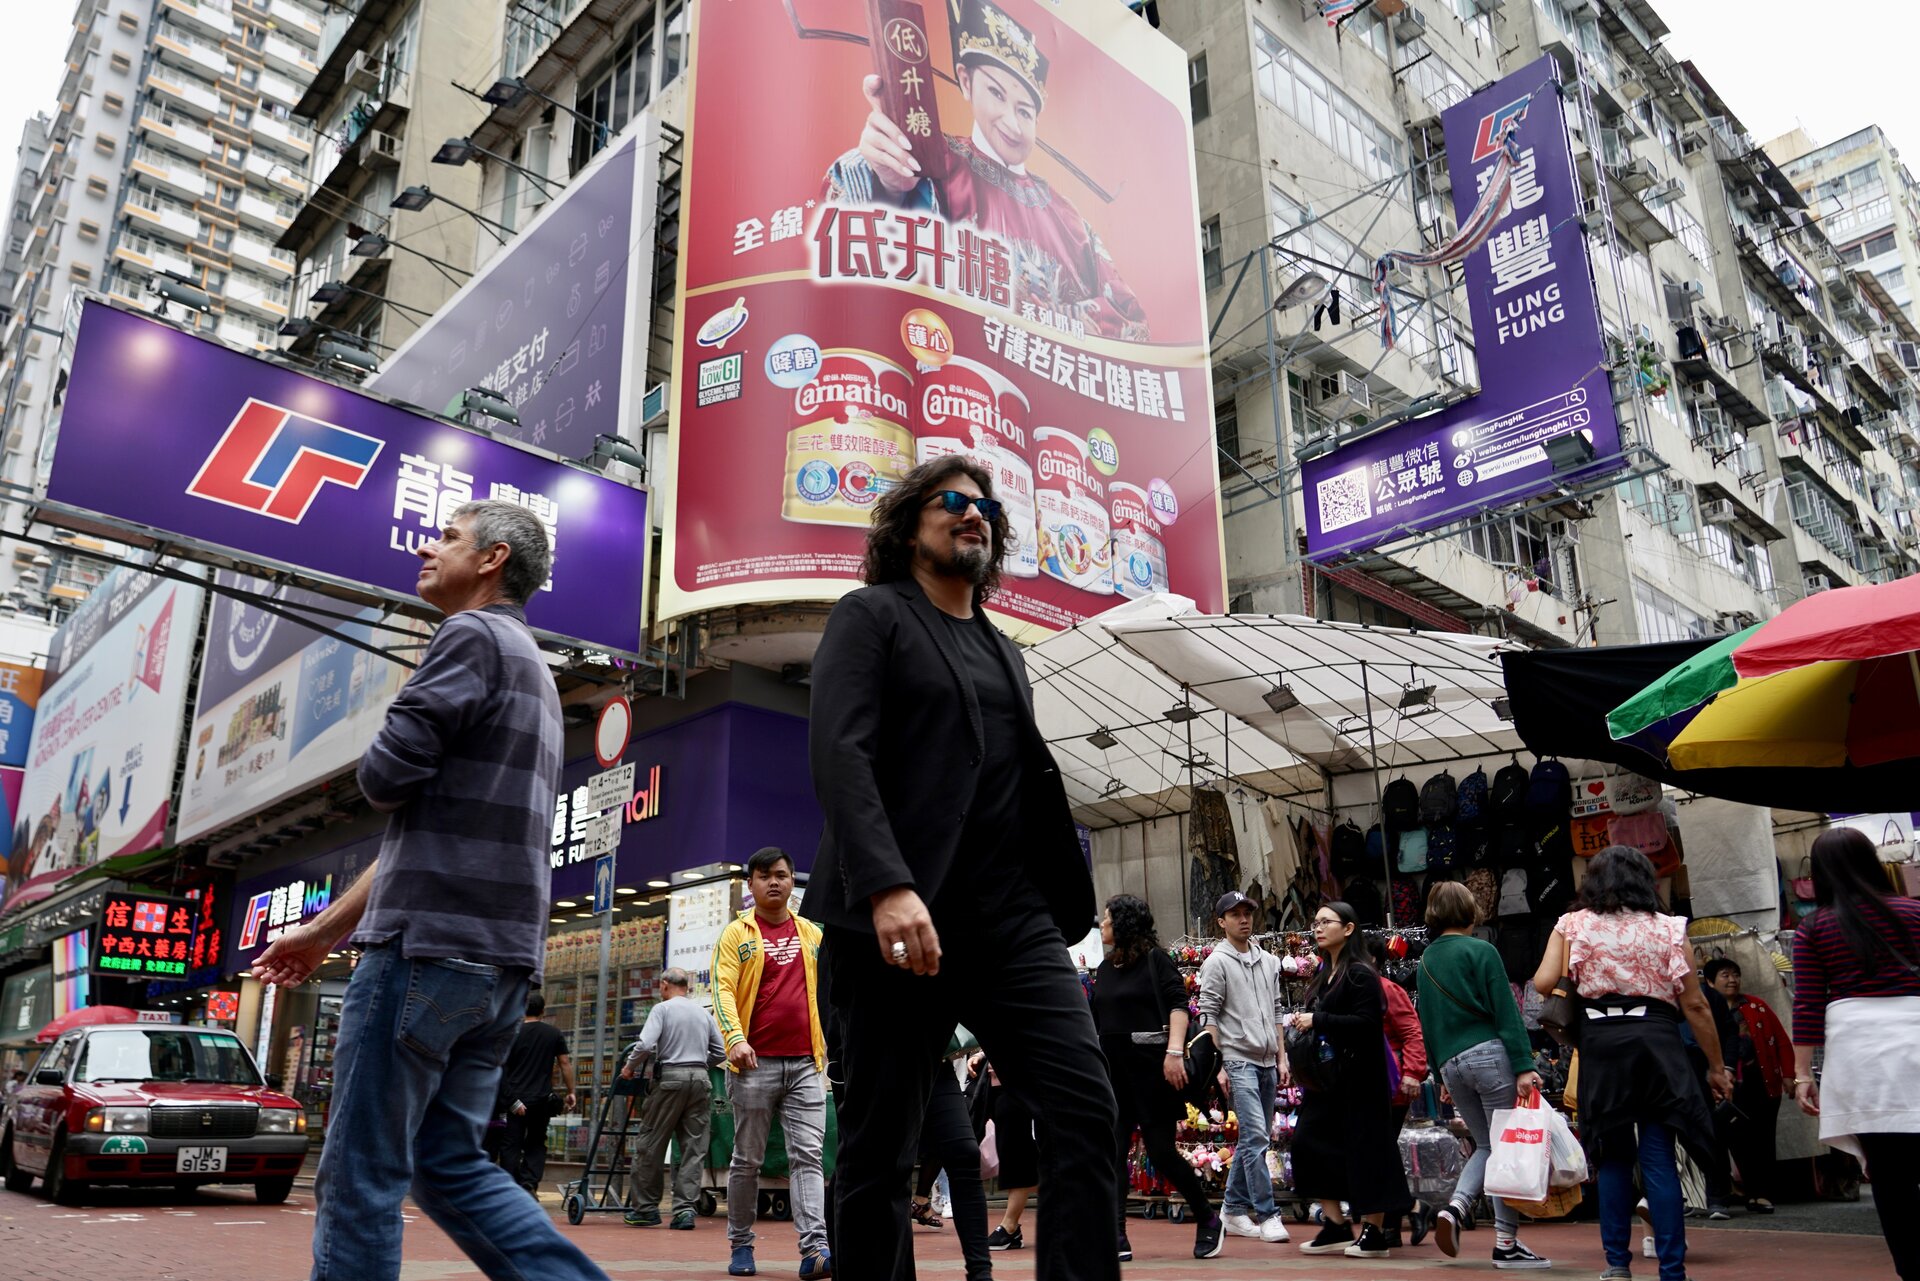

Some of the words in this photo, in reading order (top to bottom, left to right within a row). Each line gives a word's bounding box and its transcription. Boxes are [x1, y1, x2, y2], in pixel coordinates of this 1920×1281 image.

[890, 23, 932, 137] 低升糖
[813, 207, 1011, 308] 低升糖
[1495, 283, 1561, 324] LUNG
[1021, 300, 1085, 341] 系列奶粉
[1498, 303, 1566, 345] FUNG
[907, 323, 949, 353] 護心
[701, 370, 722, 387] LOW
[722, 357, 739, 381] GI
[702, 361, 723, 374] Tested
[770, 347, 818, 375] 降醇
[794, 379, 909, 420] Carnation
[922, 384, 1027, 449] Carnation
[1475, 412, 1525, 438] LungFungHK
[1090, 437, 1117, 466] 3健
[1478, 419, 1569, 458] weibo.com/lungfunghk
[1038, 449, 1105, 499] Carnation
[1371, 441, 1440, 478] 龍豐微信
[1481, 448, 1545, 476] www.lungfung.h
[1374, 459, 1444, 502] 公眾號
[1397, 486, 1446, 507] LungFungGroup
[1112, 499, 1163, 537] Carnation
[623, 766, 633, 781] 12
[105, 901, 132, 928] 信
[168, 907, 192, 935] 生
[101, 933, 188, 960] 中西大藥房
[141, 1013, 170, 1022] TAXI
[120, 1139, 130, 1148] 5
[192, 1148, 214, 1160] JM
[182, 1158, 221, 1172] 9153
